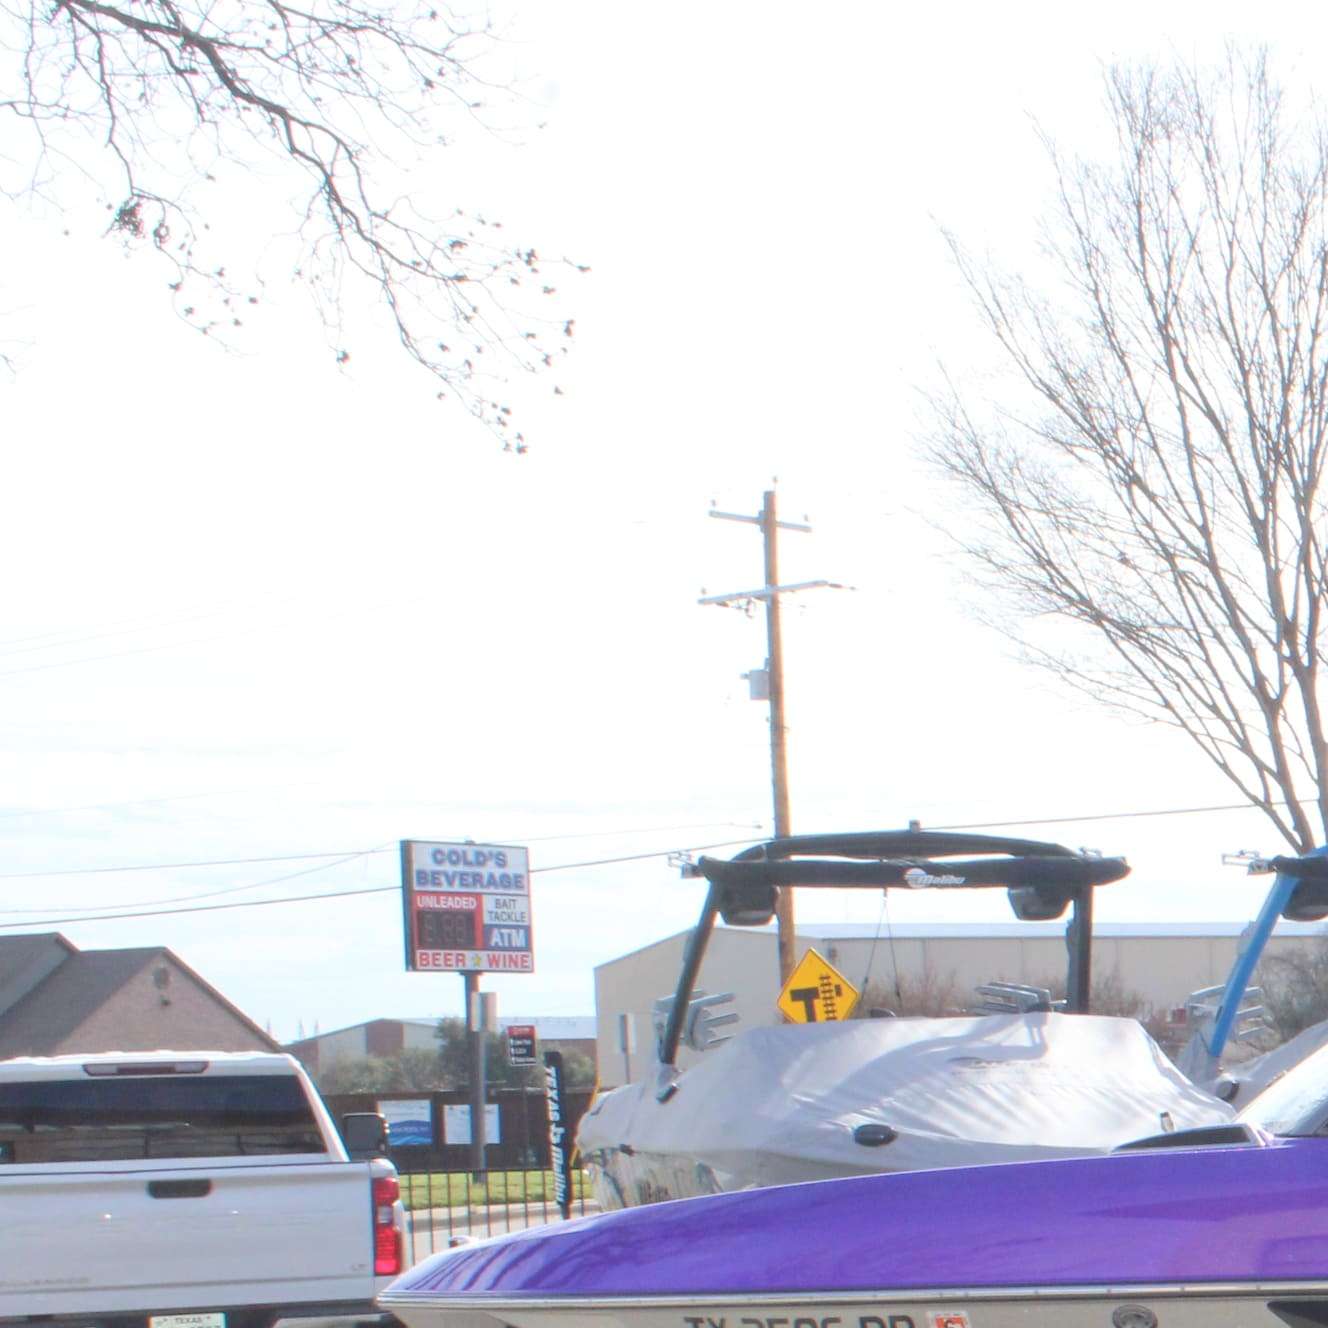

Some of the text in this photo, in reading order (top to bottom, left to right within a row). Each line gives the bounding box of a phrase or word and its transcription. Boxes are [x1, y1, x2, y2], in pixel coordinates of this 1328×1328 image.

[431, 847, 508, 868] COLD'S
[415, 869, 525, 890] BEVERAGE
[416, 895, 477, 909] UNLEADED
[495, 898, 517, 909] BAIT
[487, 911, 527, 922] TACKLE
[490, 927, 526, 948] ATM
[418, 952, 530, 969] BEER WINE
[546, 1066, 560, 1121] TEXAS
